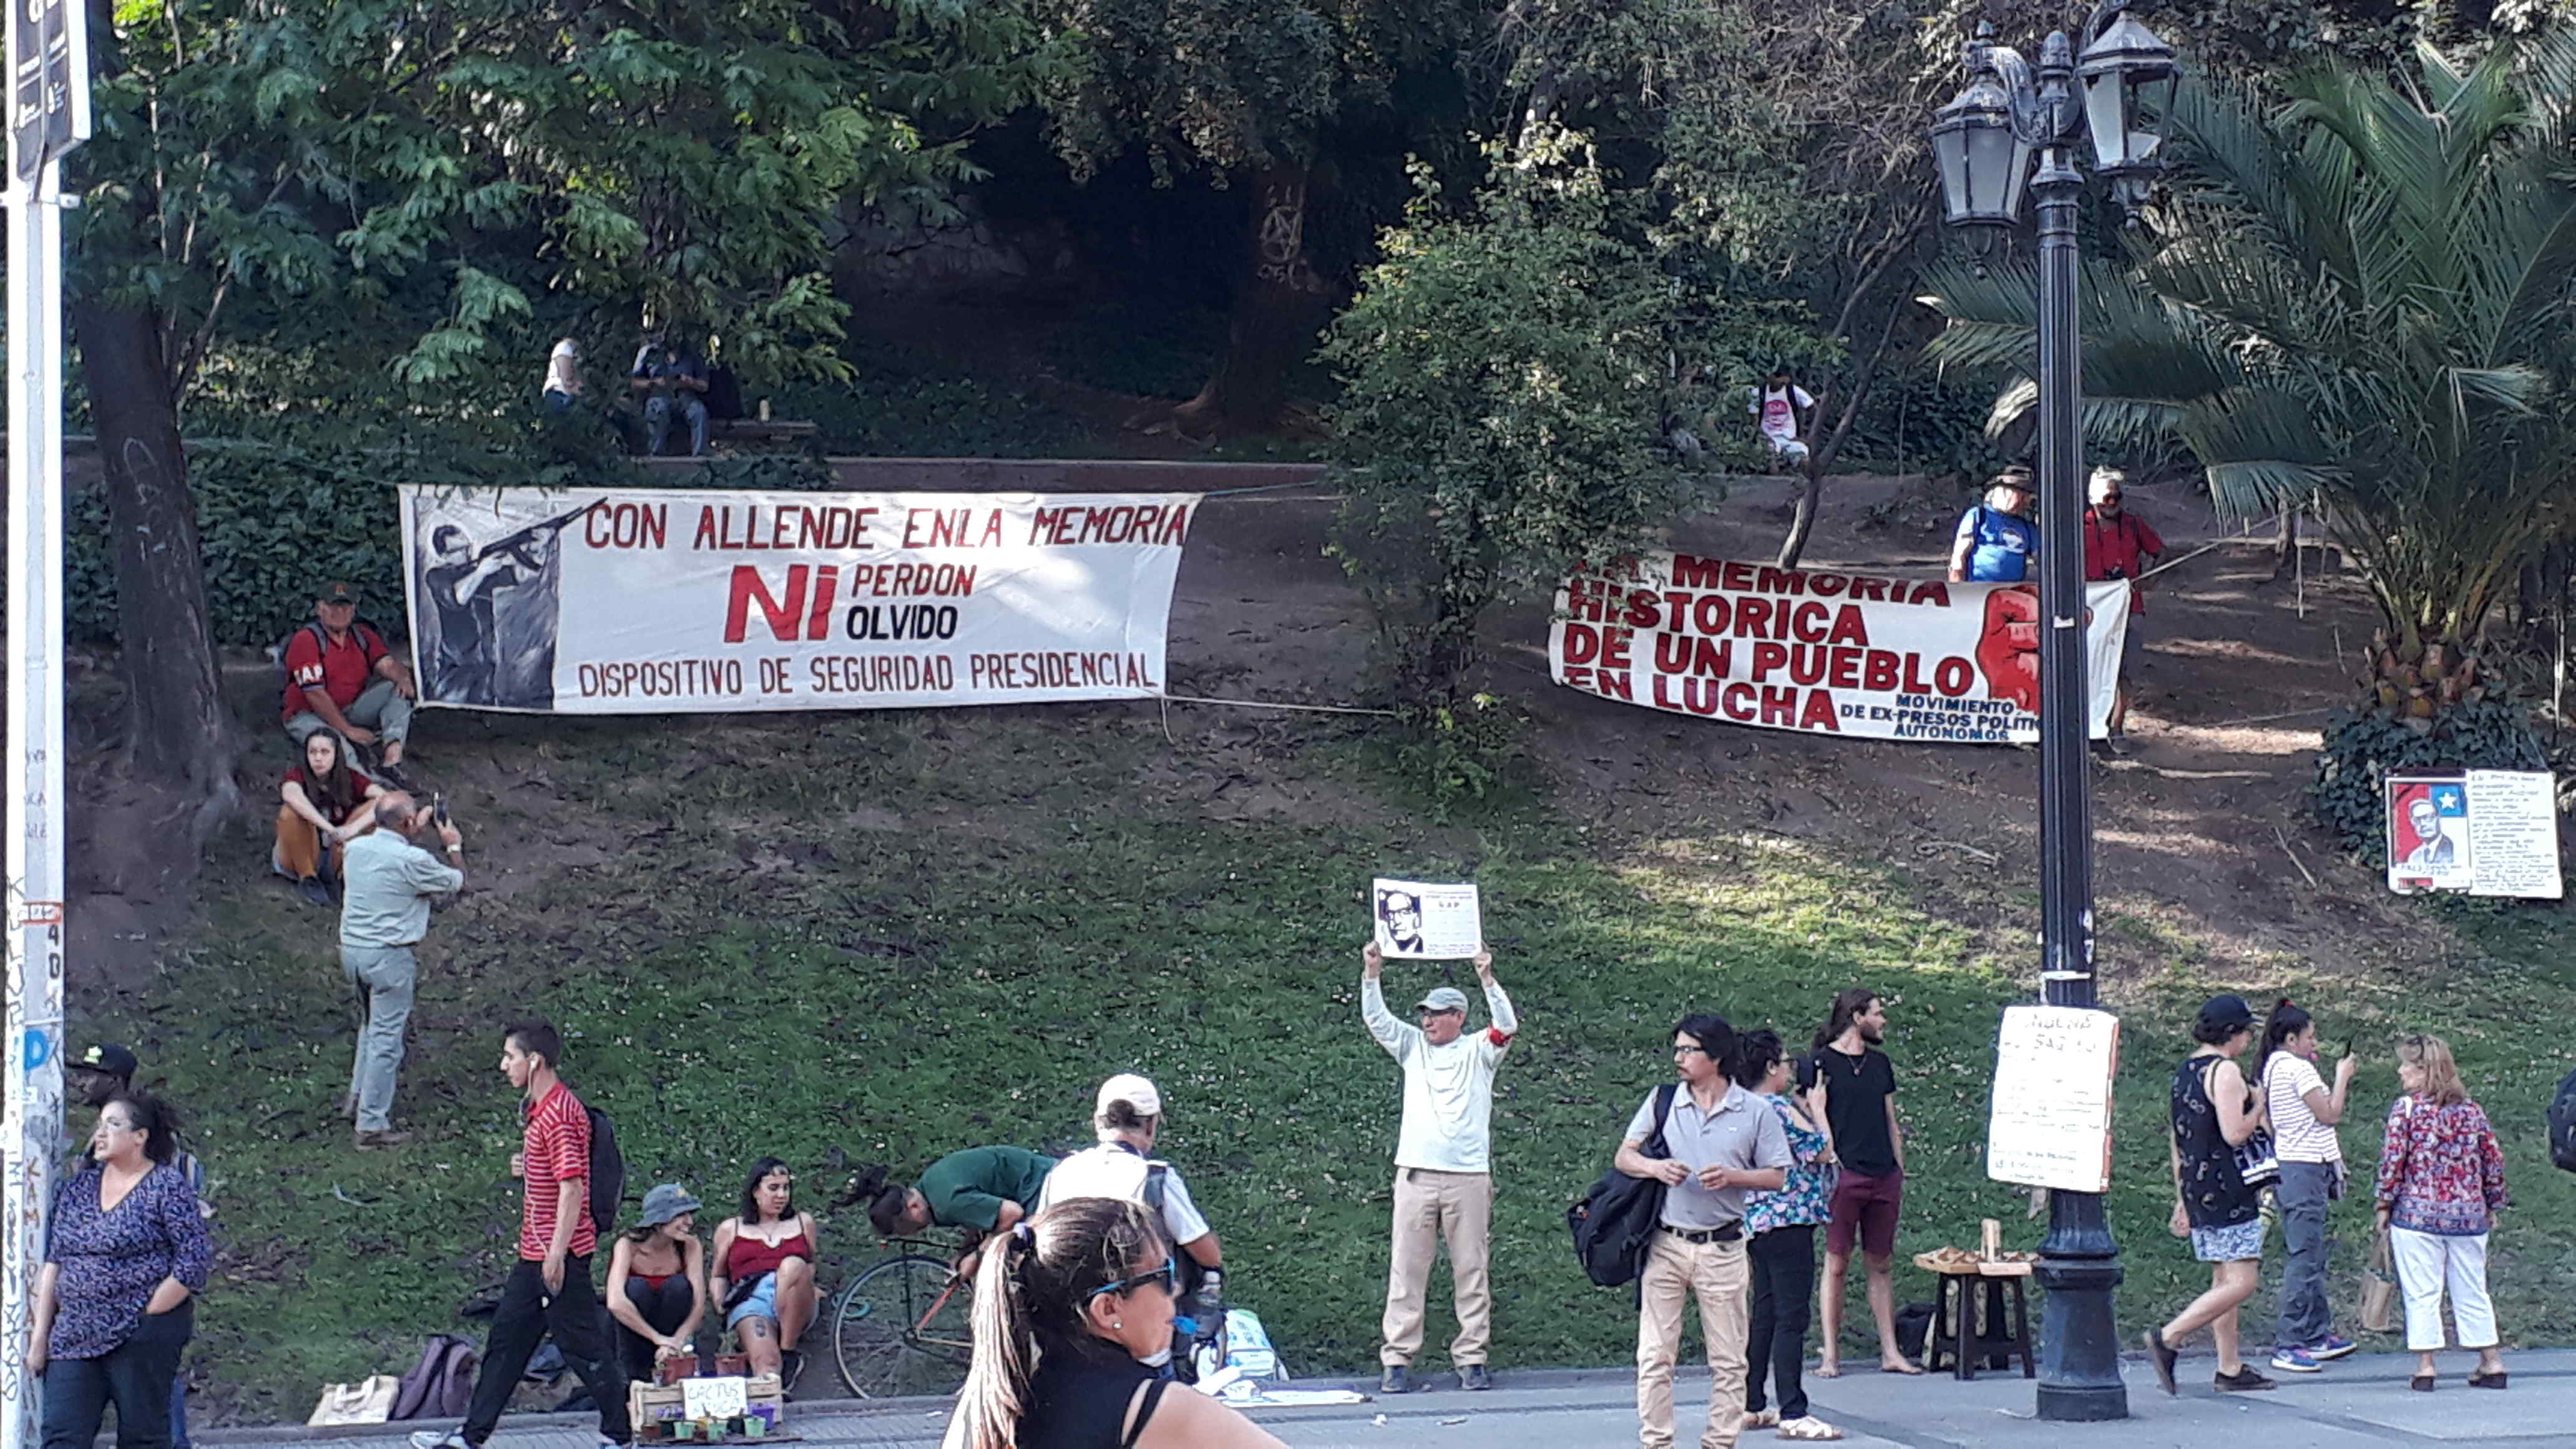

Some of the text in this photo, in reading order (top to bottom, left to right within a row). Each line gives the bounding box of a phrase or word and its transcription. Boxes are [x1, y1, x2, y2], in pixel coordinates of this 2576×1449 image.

[584, 502, 667, 550] CON
[693, 505, 879, 550] ALLENDE
[1028, 504, 1188, 547] MEMORIA
[851, 563, 978, 598] PERDON
[1671, 554, 1951, 607] MEMORIA
[846, 605, 959, 641] OLVIDO
[1568, 578, 1870, 646] HISTORICA
[579, 651, 1159, 698] DISPOSITIVO DE SEGURIDAD PRESIDENCIAL
[1564, 623, 1974, 697] DE UN PUEBLO
[1563, 666, 1840, 731] EN LUCHA
[1840, 703, 1865, 720] DE
[1896, 694, 2014, 715] MOVIMIENTO
[1894, 724, 2009, 741] AUTONOMOS
